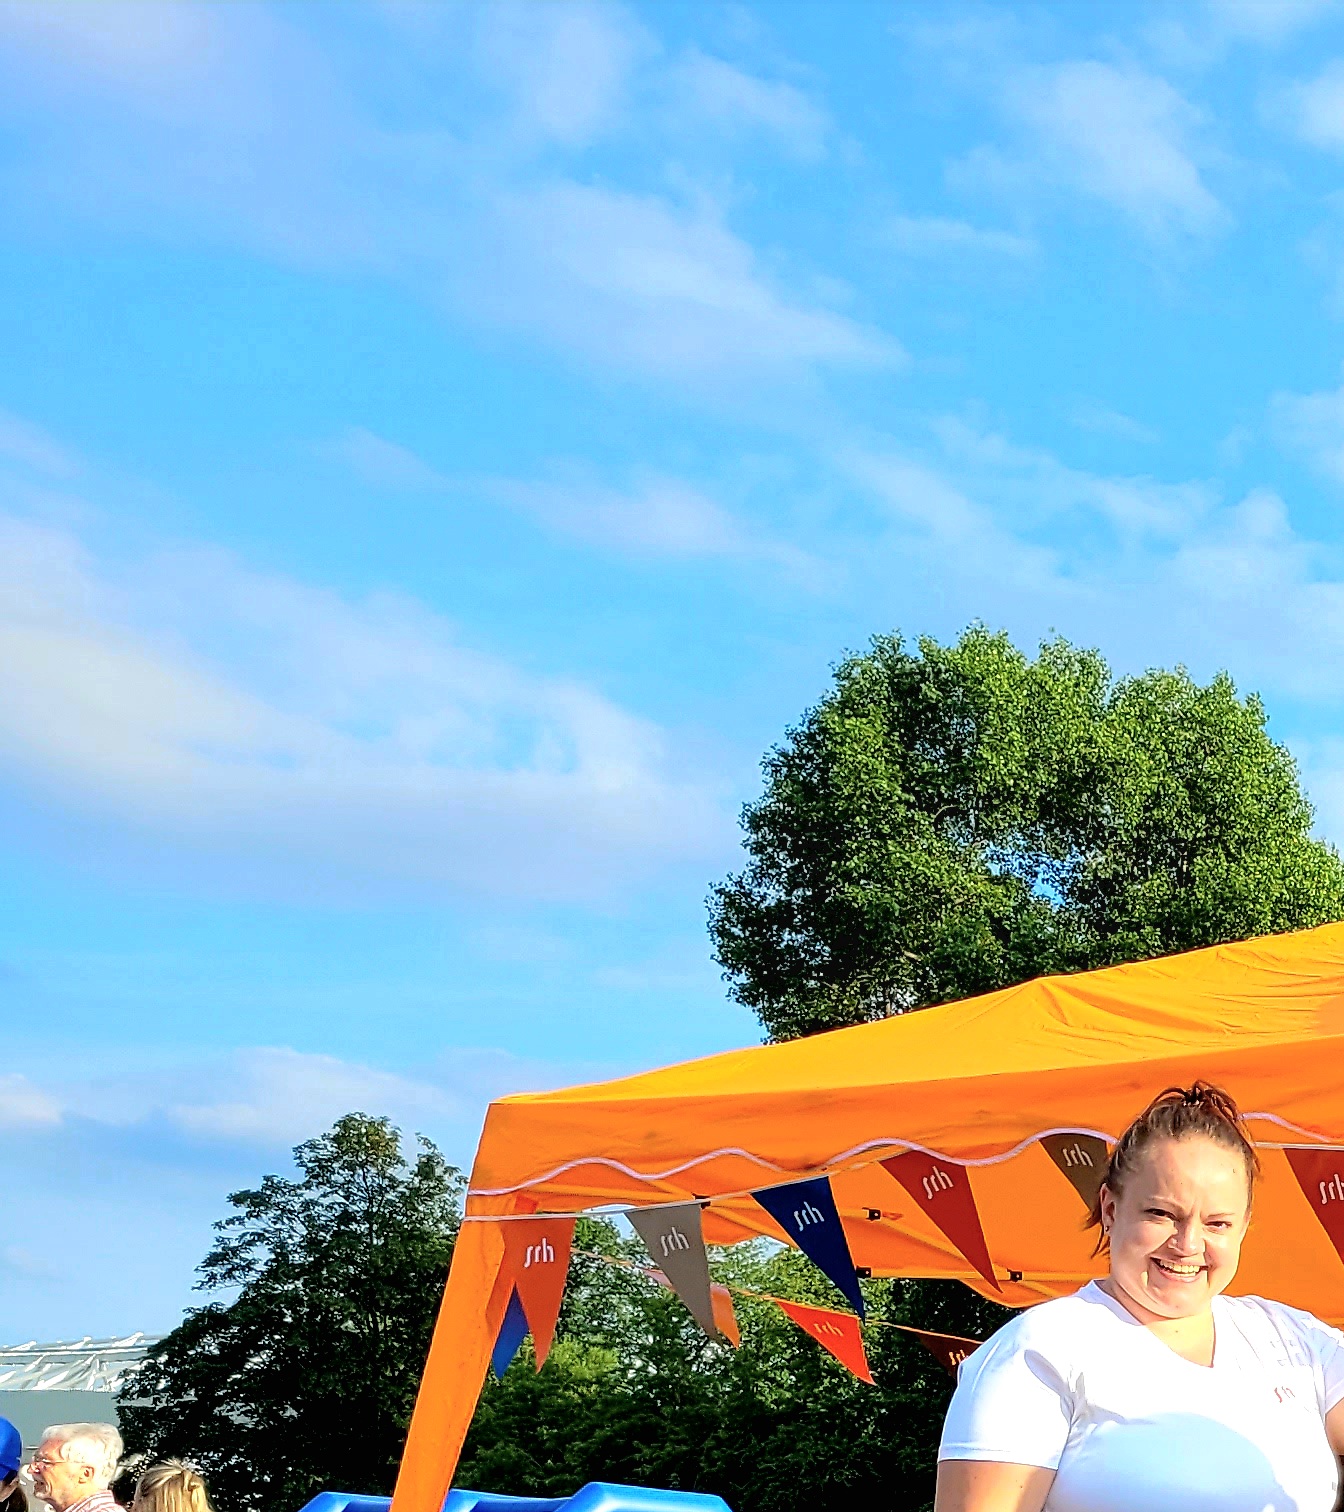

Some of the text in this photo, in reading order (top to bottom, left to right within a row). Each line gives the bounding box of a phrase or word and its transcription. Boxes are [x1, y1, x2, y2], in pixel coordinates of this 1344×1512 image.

[1062, 1143, 1094, 1167] srh
[922, 1165, 954, 1200] srh
[793, 1201, 825, 1232] srh
[523, 1237, 554, 1268] srh
[660, 1226, 690, 1257] srh
[813, 1321, 844, 1337] srh
